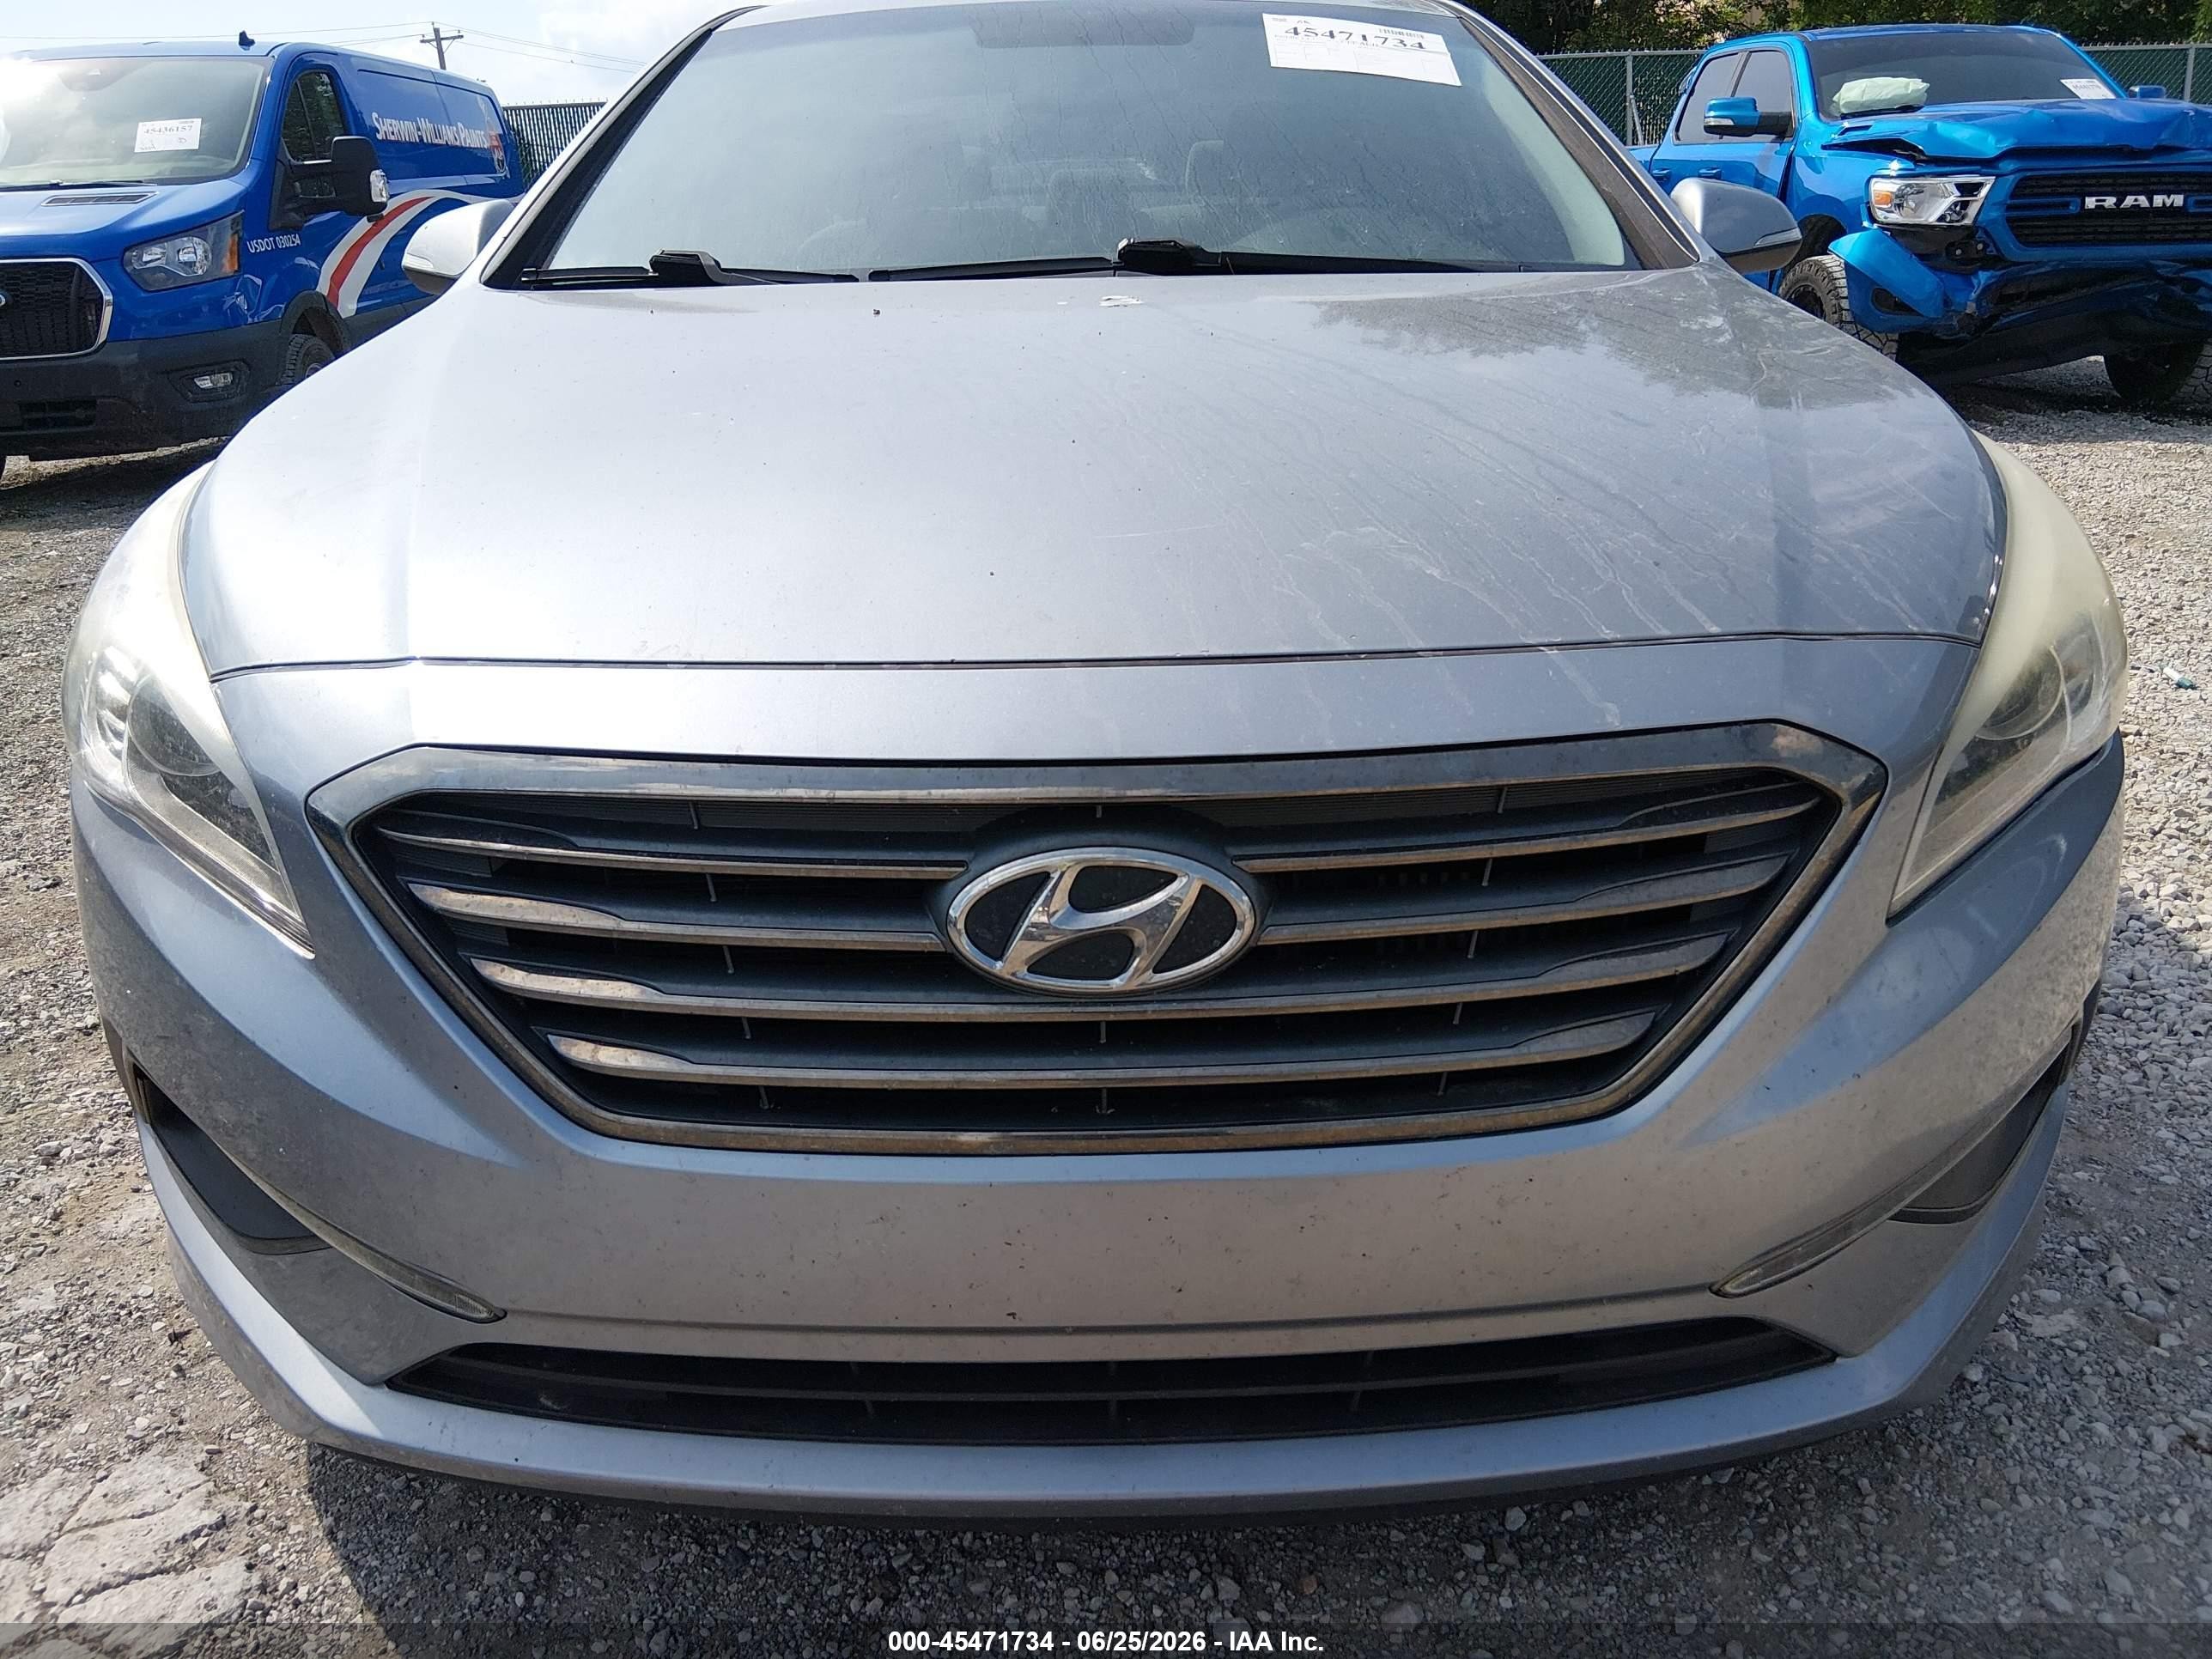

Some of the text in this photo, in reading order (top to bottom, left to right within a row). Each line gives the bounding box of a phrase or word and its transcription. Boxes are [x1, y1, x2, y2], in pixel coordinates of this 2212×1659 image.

[1285, 27, 1426, 49] 45471734
[372, 112, 488, 149] SHERWIN-WILLIAMS PAINTS
[2085, 194, 2184, 210] RAM
[246, 234, 301, 253] USDOT 030254
